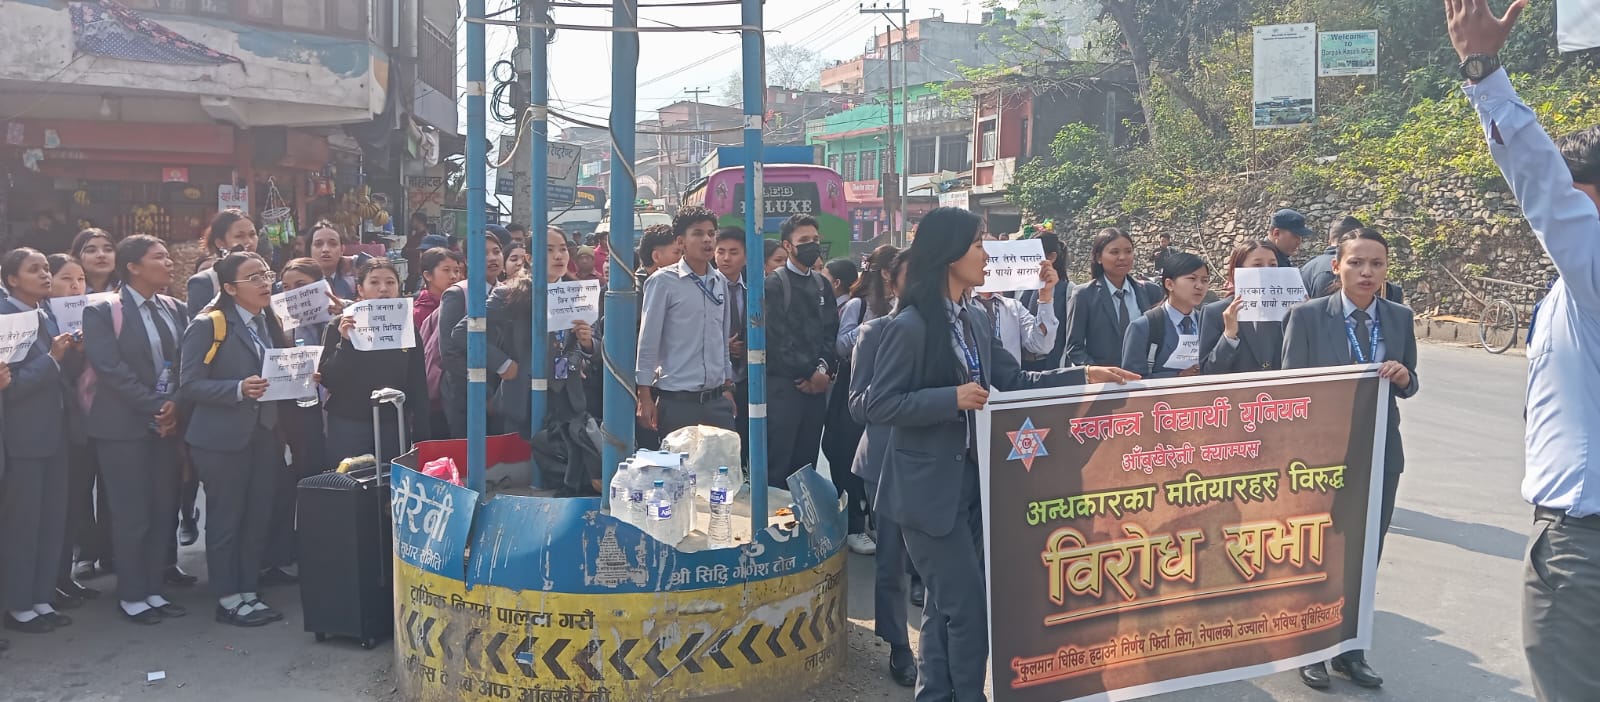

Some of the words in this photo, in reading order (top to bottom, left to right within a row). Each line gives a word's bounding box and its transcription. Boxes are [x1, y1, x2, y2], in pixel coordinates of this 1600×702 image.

[1269, 284, 1283, 295] तेरो
[1069, 411, 1144, 444] स्वतन्त्र
[1152, 396, 1230, 434] विद्यार्थी
[1239, 392, 1312, 433] युनियन
[1121, 441, 1194, 475] आँबुखैरेनी
[1201, 440, 1262, 463] क्याम्पस
[1025, 486, 1157, 527] अन्धकारका
[1166, 470, 1281, 508] मतियारहरु
[1289, 460, 1347, 493] विरुद्ध
[671, 565, 691, 586] श्री
[1042, 524, 1204, 604] विरोध
[1223, 512, 1334, 580] सभा
[1121, 634, 1145, 656] निर्णय
[1149, 630, 1170, 651] फिर्ता
[1199, 619, 1234, 643] नेपालको
[1272, 611, 1298, 631] भविष्य
